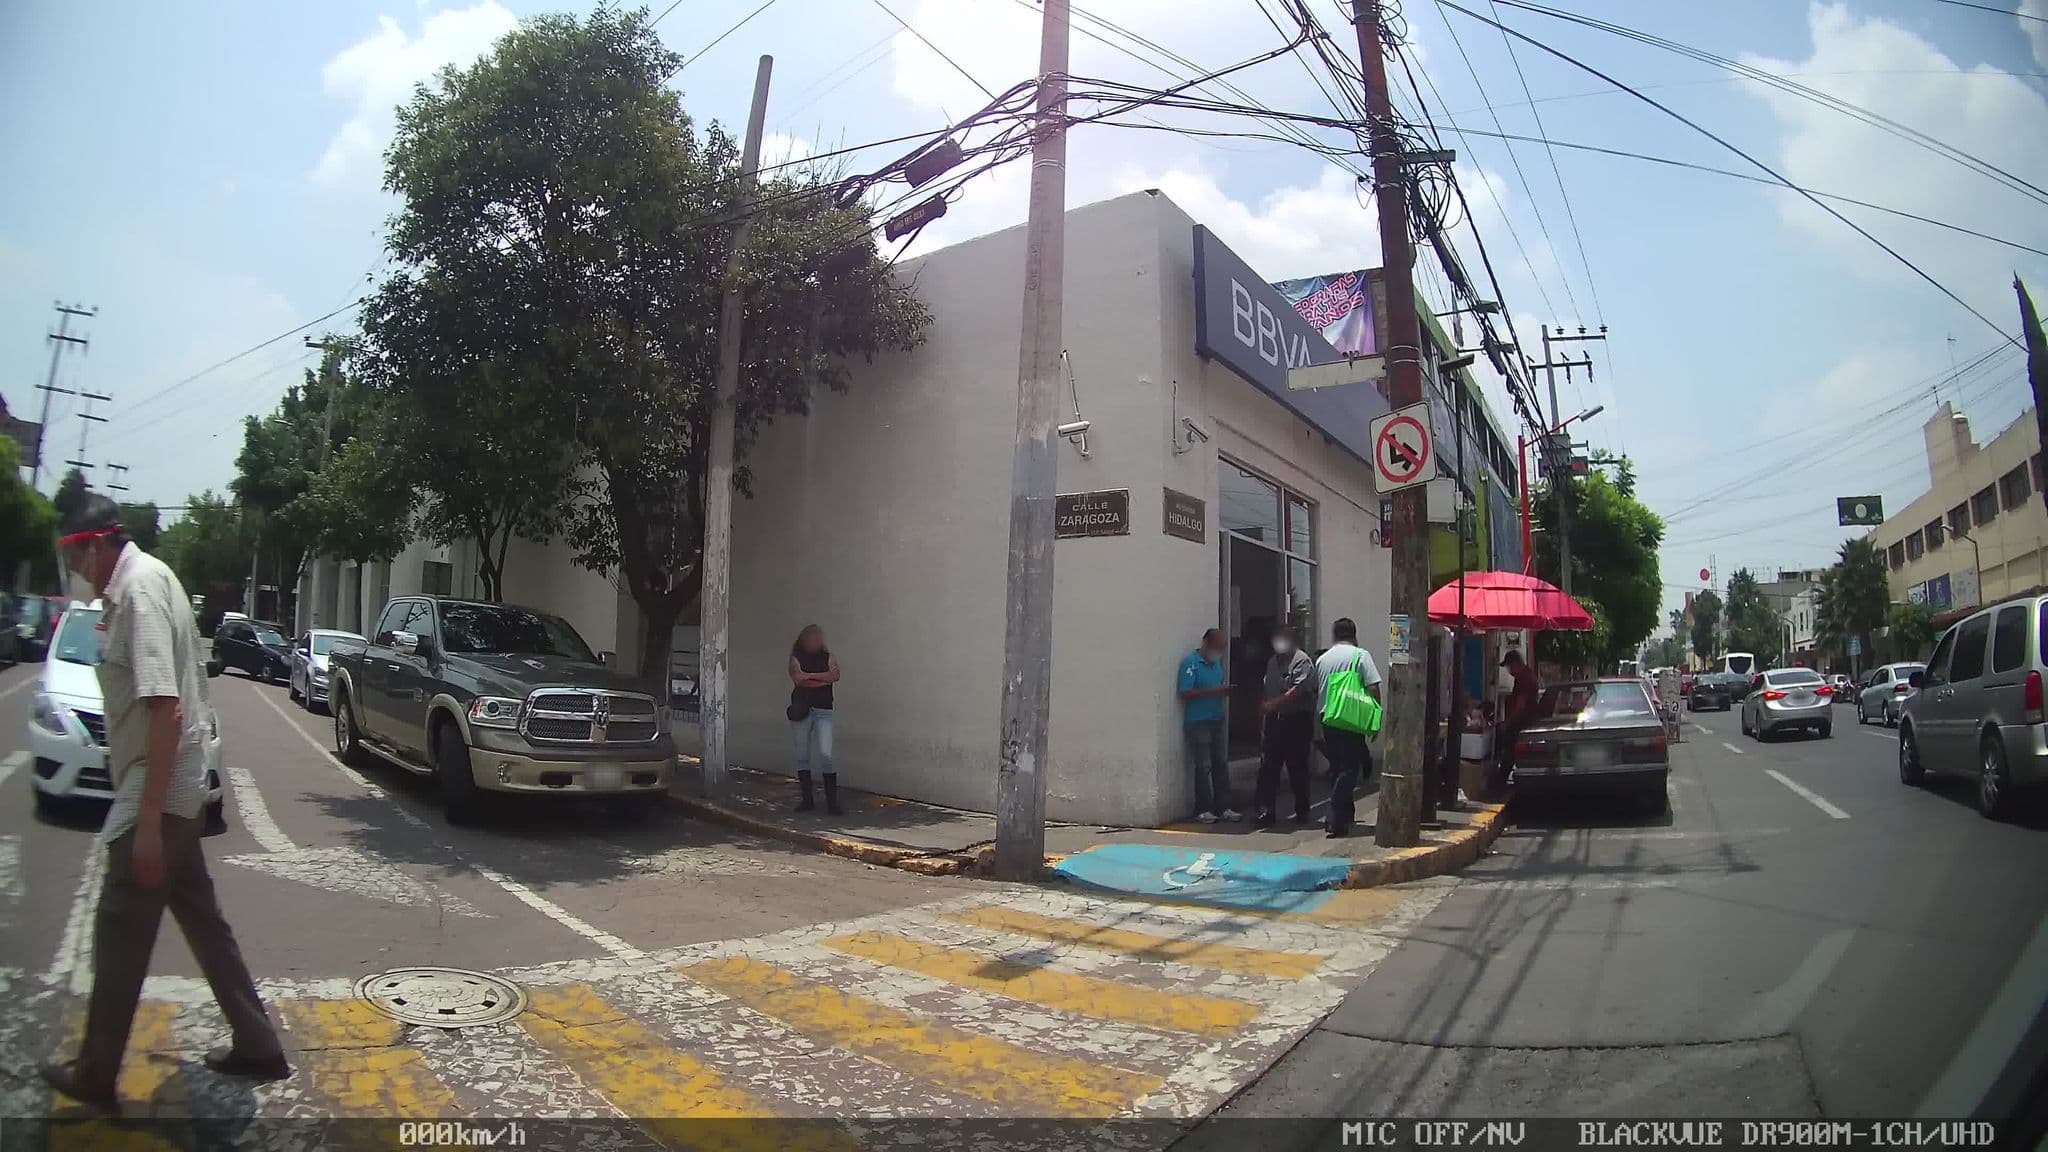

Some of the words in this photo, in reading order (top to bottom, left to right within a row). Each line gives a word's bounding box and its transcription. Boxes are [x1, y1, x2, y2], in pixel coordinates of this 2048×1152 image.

[1231, 276, 1312, 369] BBVA
[1072, 501, 1109, 511] CALLE
[1060, 512, 1120, 527] ZARAGOZA
[1169, 511, 1202, 531] HIDALGO
